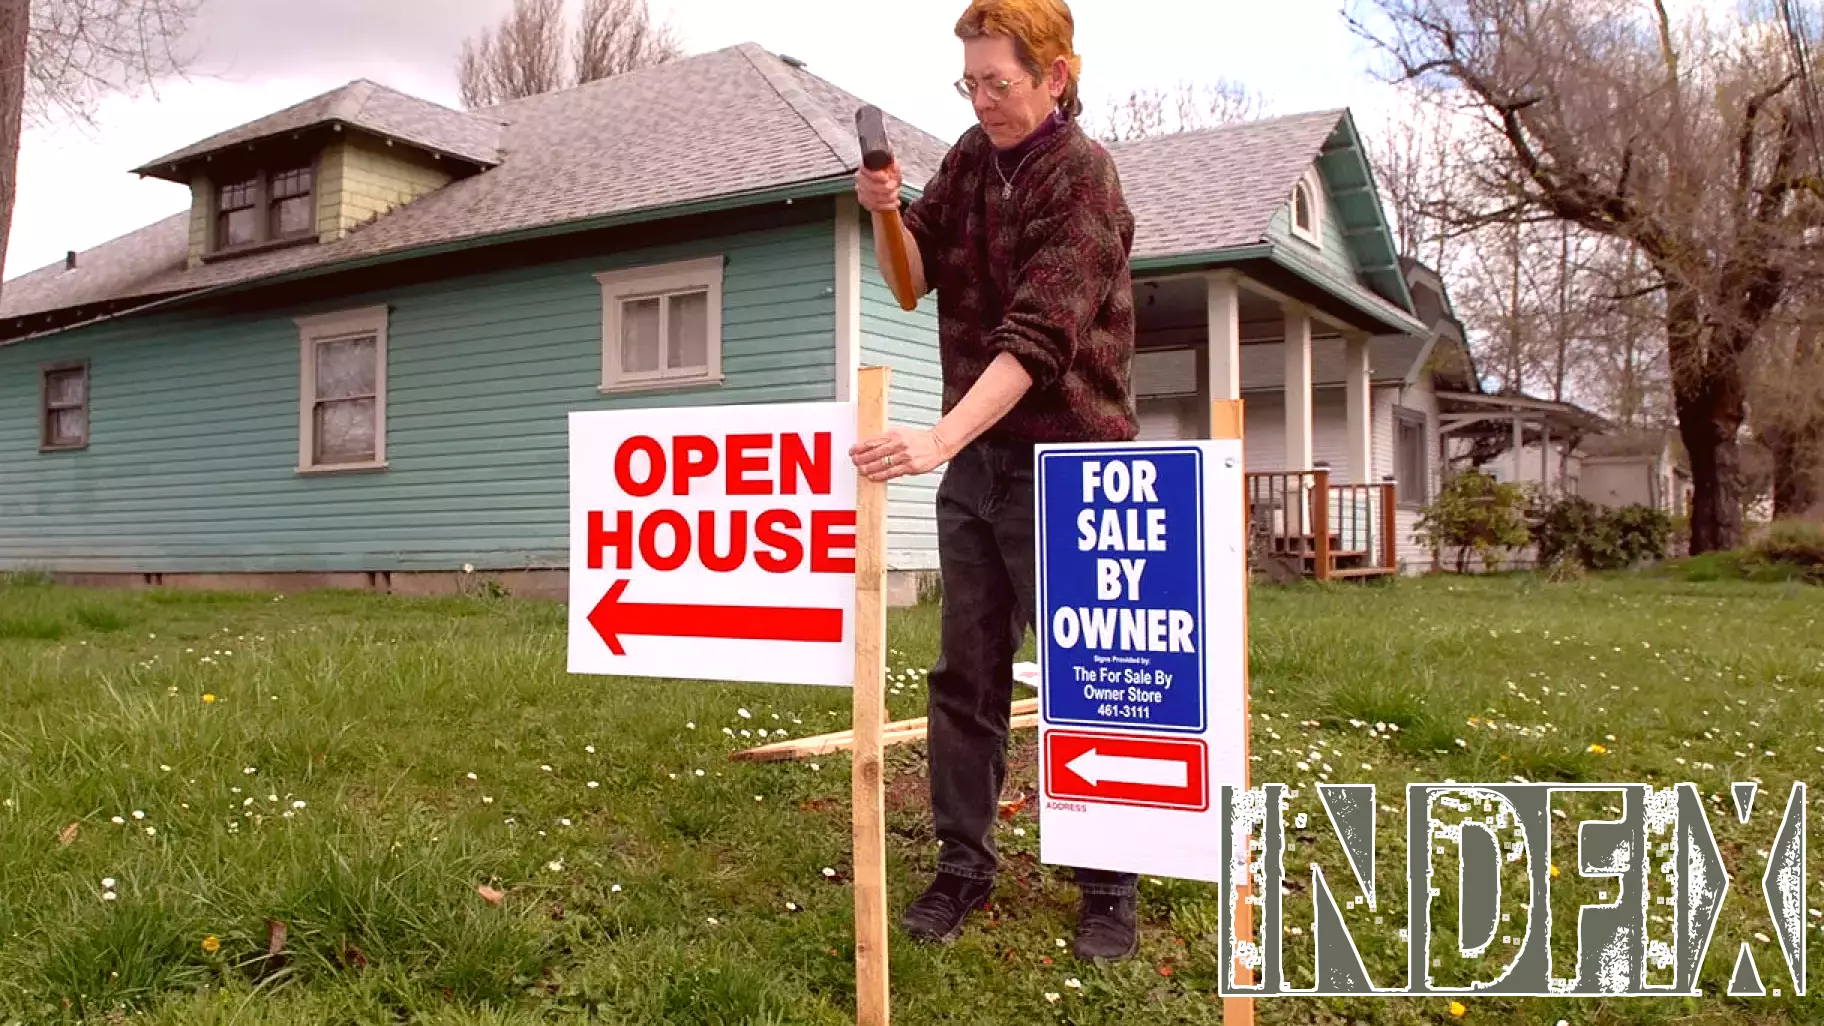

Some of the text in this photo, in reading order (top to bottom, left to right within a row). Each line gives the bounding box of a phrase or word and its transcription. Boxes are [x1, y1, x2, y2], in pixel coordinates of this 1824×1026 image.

[614, 431, 832, 497] OPEN
[1082, 460, 1159, 503] FOR
[587, 508, 857, 573] HOUSE
[1077, 508, 1167, 551] SALE
[1097, 558, 1147, 601] BY
[1052, 606, 1195, 653] OWNER
[1073, 666, 1173, 689] The For Sale By
[1084, 684, 1162, 703] Owner Store
[1097, 704, 1150, 719] 461-3111
[1046, 802, 1087, 812] ADDRESS
